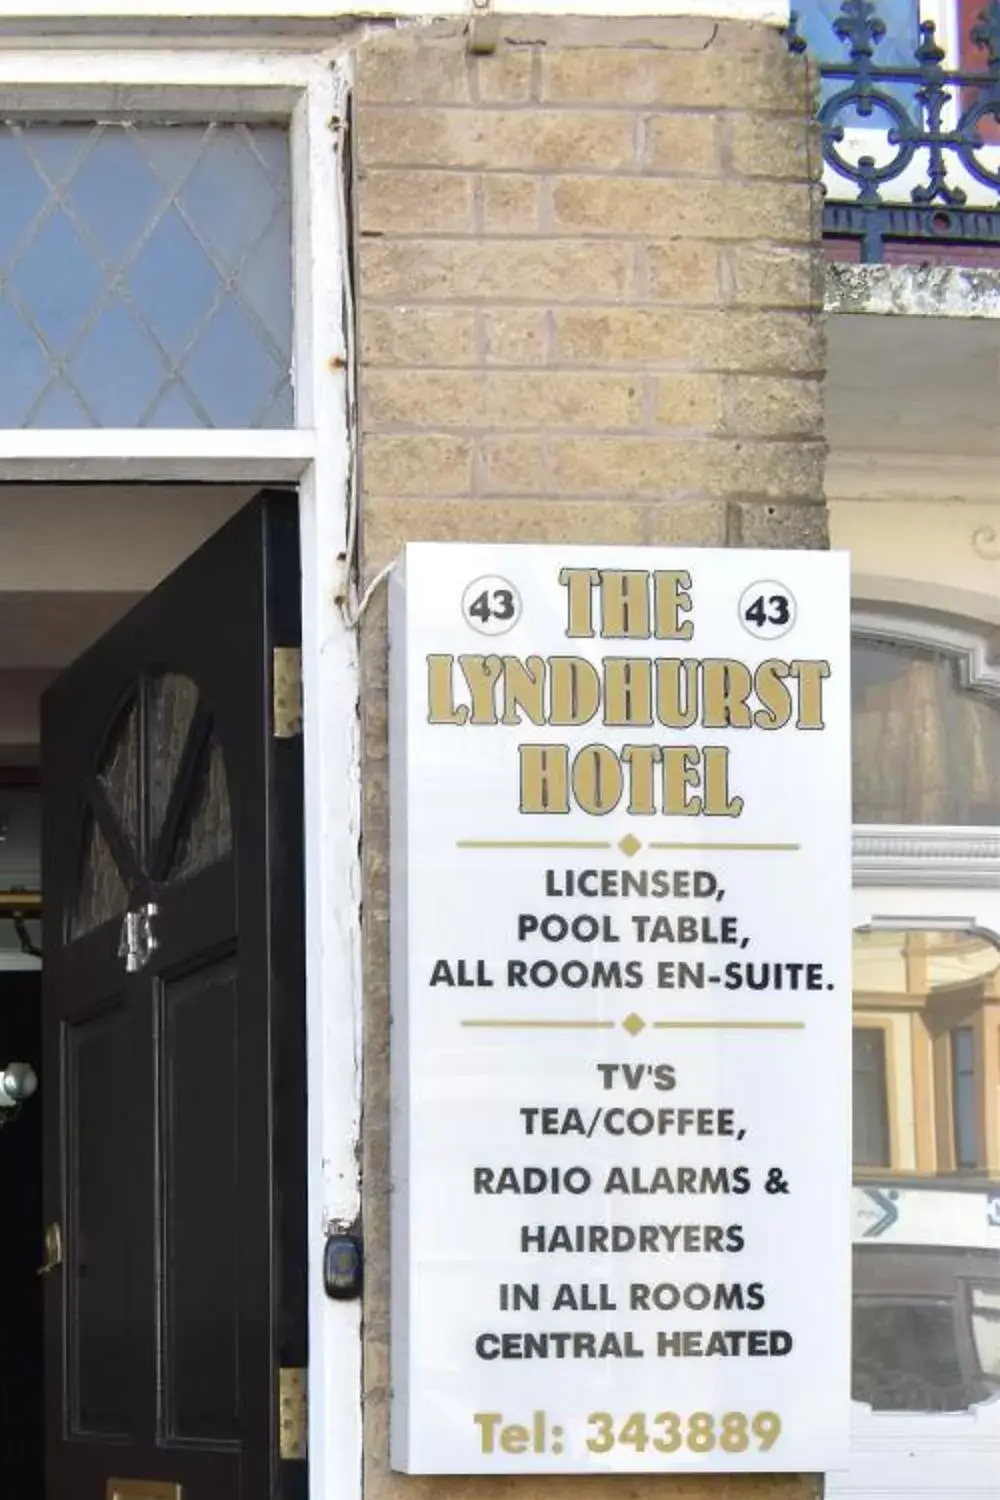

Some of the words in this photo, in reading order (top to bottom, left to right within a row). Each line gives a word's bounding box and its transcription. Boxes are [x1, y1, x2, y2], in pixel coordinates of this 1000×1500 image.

[469, 590, 515, 623] 43
[558, 567, 694, 641] THE
[745, 595, 790, 628] 43
[426, 654, 831, 731] LYNDHURST
[518, 742, 744, 818] HOTEL
[546, 869, 726, 902] LICENSED,
[518, 914, 620, 943] POOL
[632, 916, 751, 949] TABLE,
[429, 960, 494, 988] ALL
[507, 960, 643, 989] ROOMS
[658, 961, 835, 991] EN-SUITE.
[597, 1064, 676, 1091] TV'S
[520, 1107, 747, 1141] TEA/COFFEE,
[474, 1166, 592, 1195] RADIO
[604, 1166, 751, 1195] ALARMS
[764, 1167, 790, 1195] &
[521, 1224, 745, 1253] HAIRDRYERS
[500, 1283, 539, 1311] IN
[552, 1283, 616, 1311] ALL
[630, 1282, 765, 1311] ROOMS
[475, 1332, 644, 1360] CENTRAL
[657, 1330, 793, 1357] HEATED
[474, 1411, 563, 1454] Tel:
[587, 1412, 782, 1452] 343889
